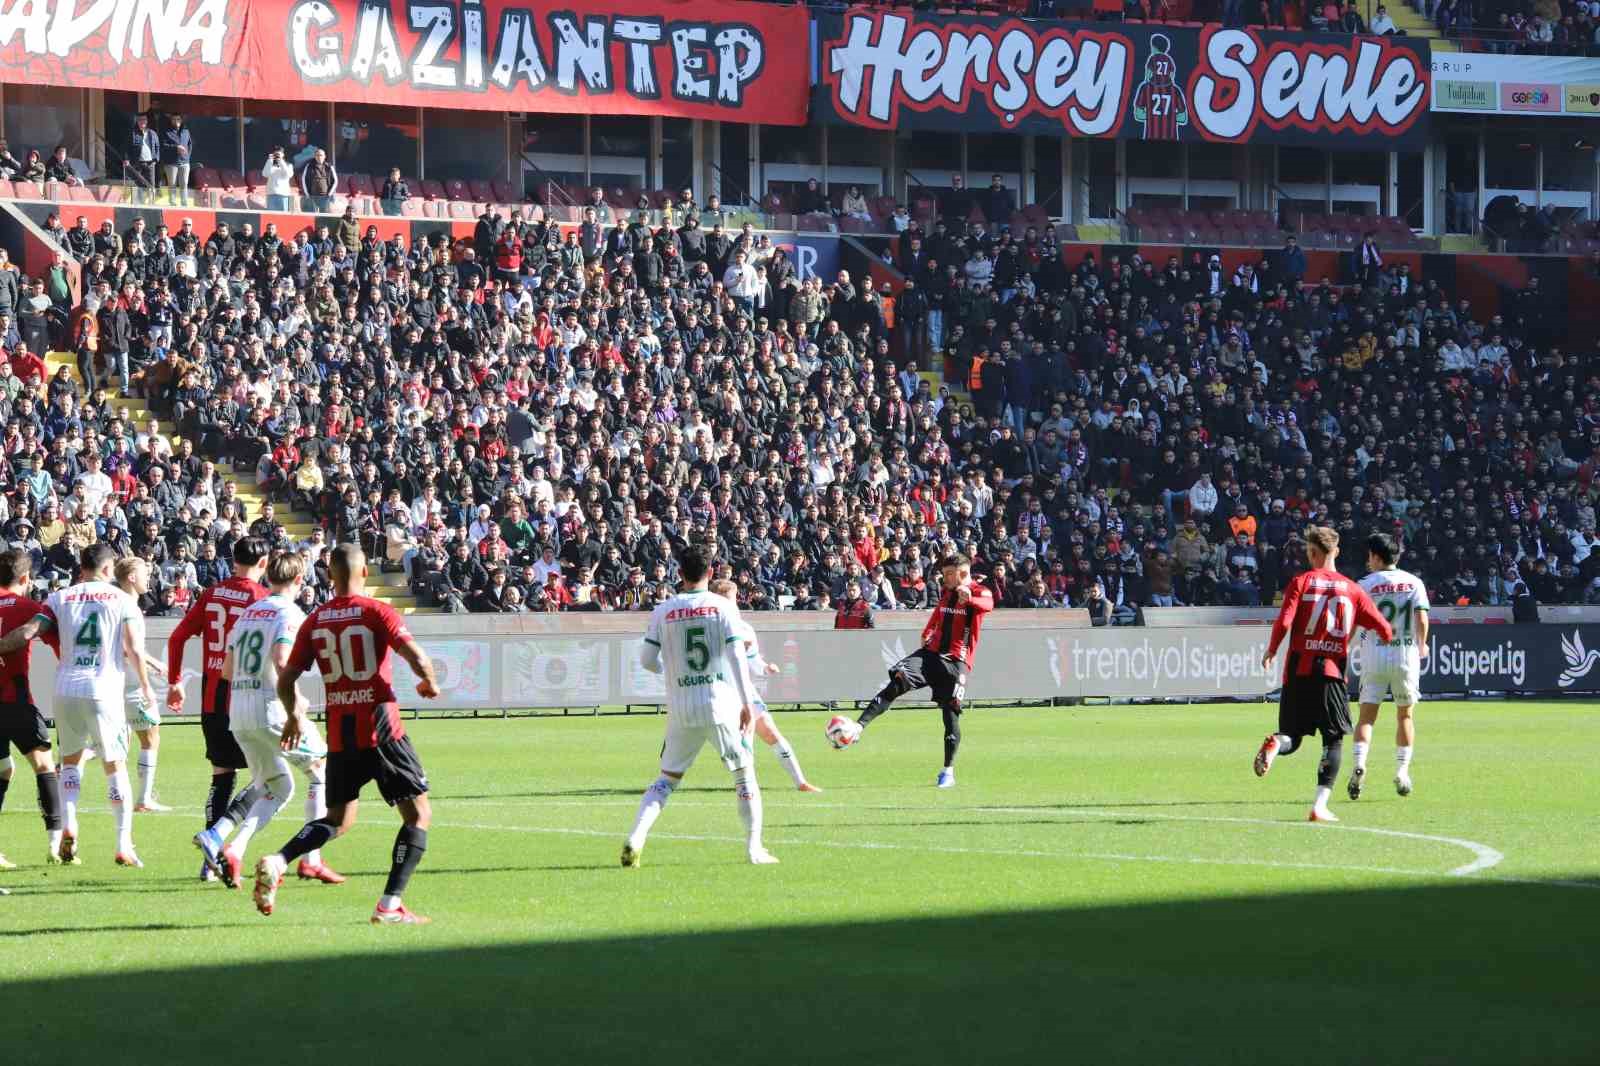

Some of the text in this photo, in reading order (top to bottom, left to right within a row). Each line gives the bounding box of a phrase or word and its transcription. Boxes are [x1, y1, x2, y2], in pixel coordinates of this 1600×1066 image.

[1156, 61, 1168, 75] 27
[1198, 29, 1425, 138] Senle
[1151, 94, 1171, 116] 27
[75, 611, 102, 648] 4
[1302, 593, 1354, 638] 70
[236, 630, 264, 674] 18
[311, 625, 377, 684] 30
[686, 626, 710, 672] 5
[1072, 638, 1188, 689] trendyol
